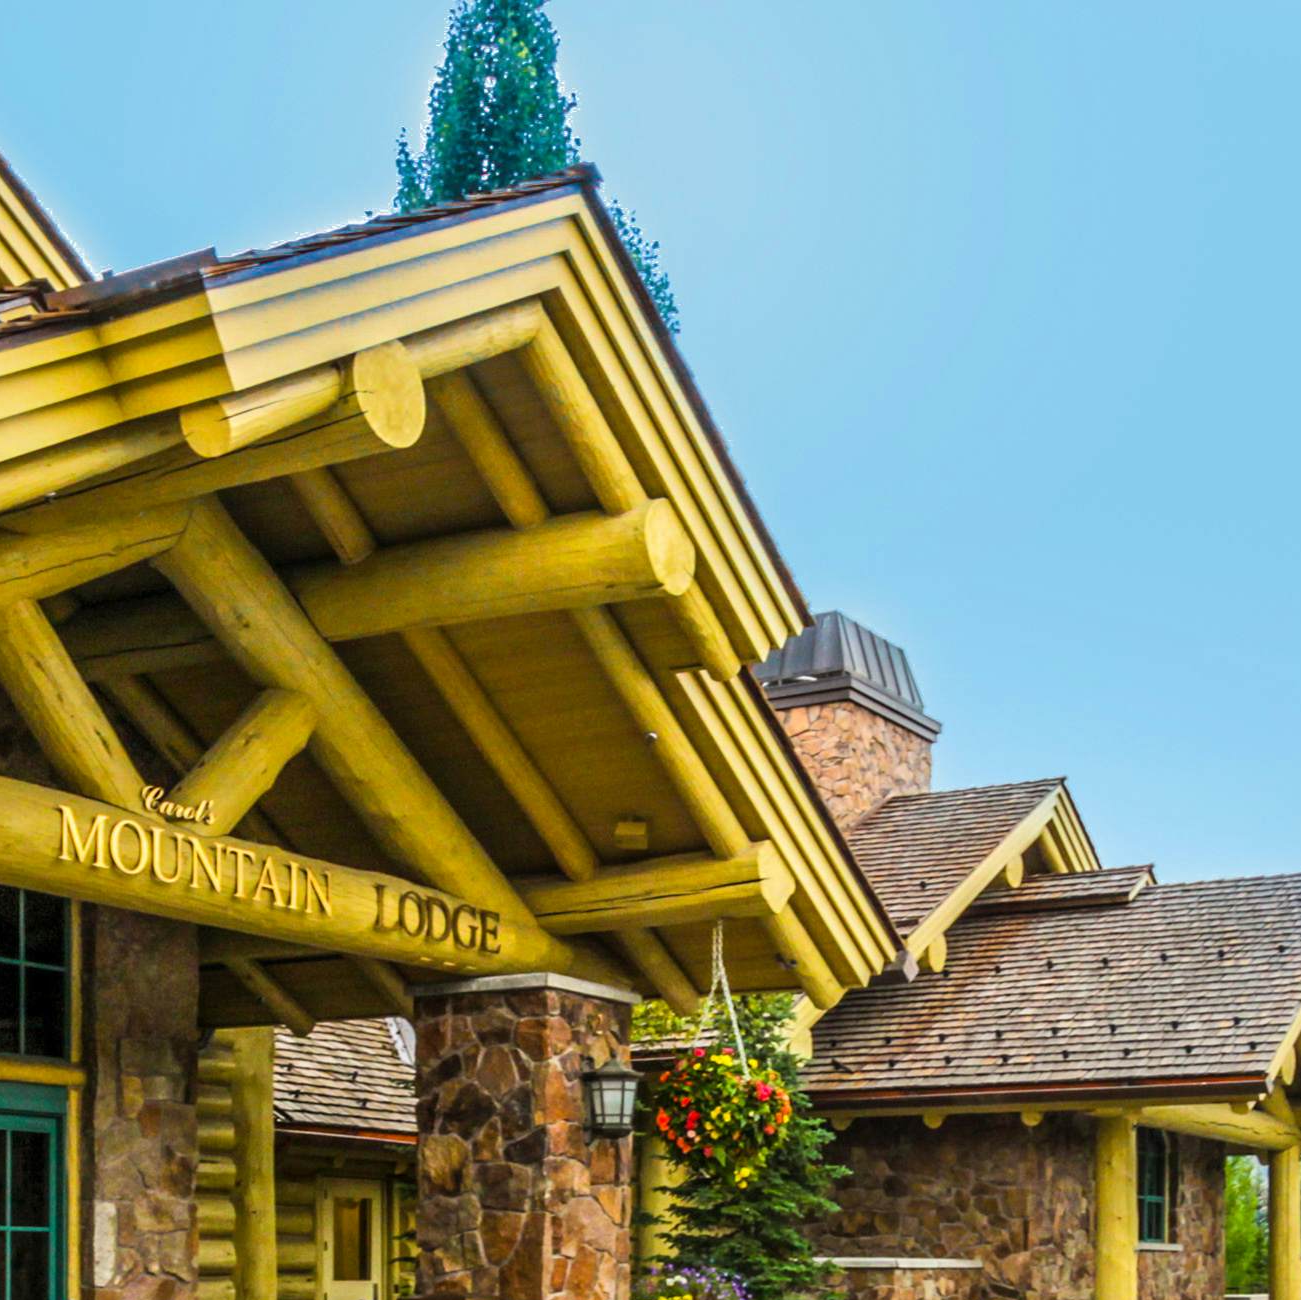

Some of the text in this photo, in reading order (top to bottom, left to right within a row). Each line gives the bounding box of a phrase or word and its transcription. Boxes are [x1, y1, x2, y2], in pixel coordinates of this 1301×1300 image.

[141, 785, 216, 825] Carol's
[58, 804, 333, 918] MOUNTAIN
[372, 882, 502, 955] LODGE
